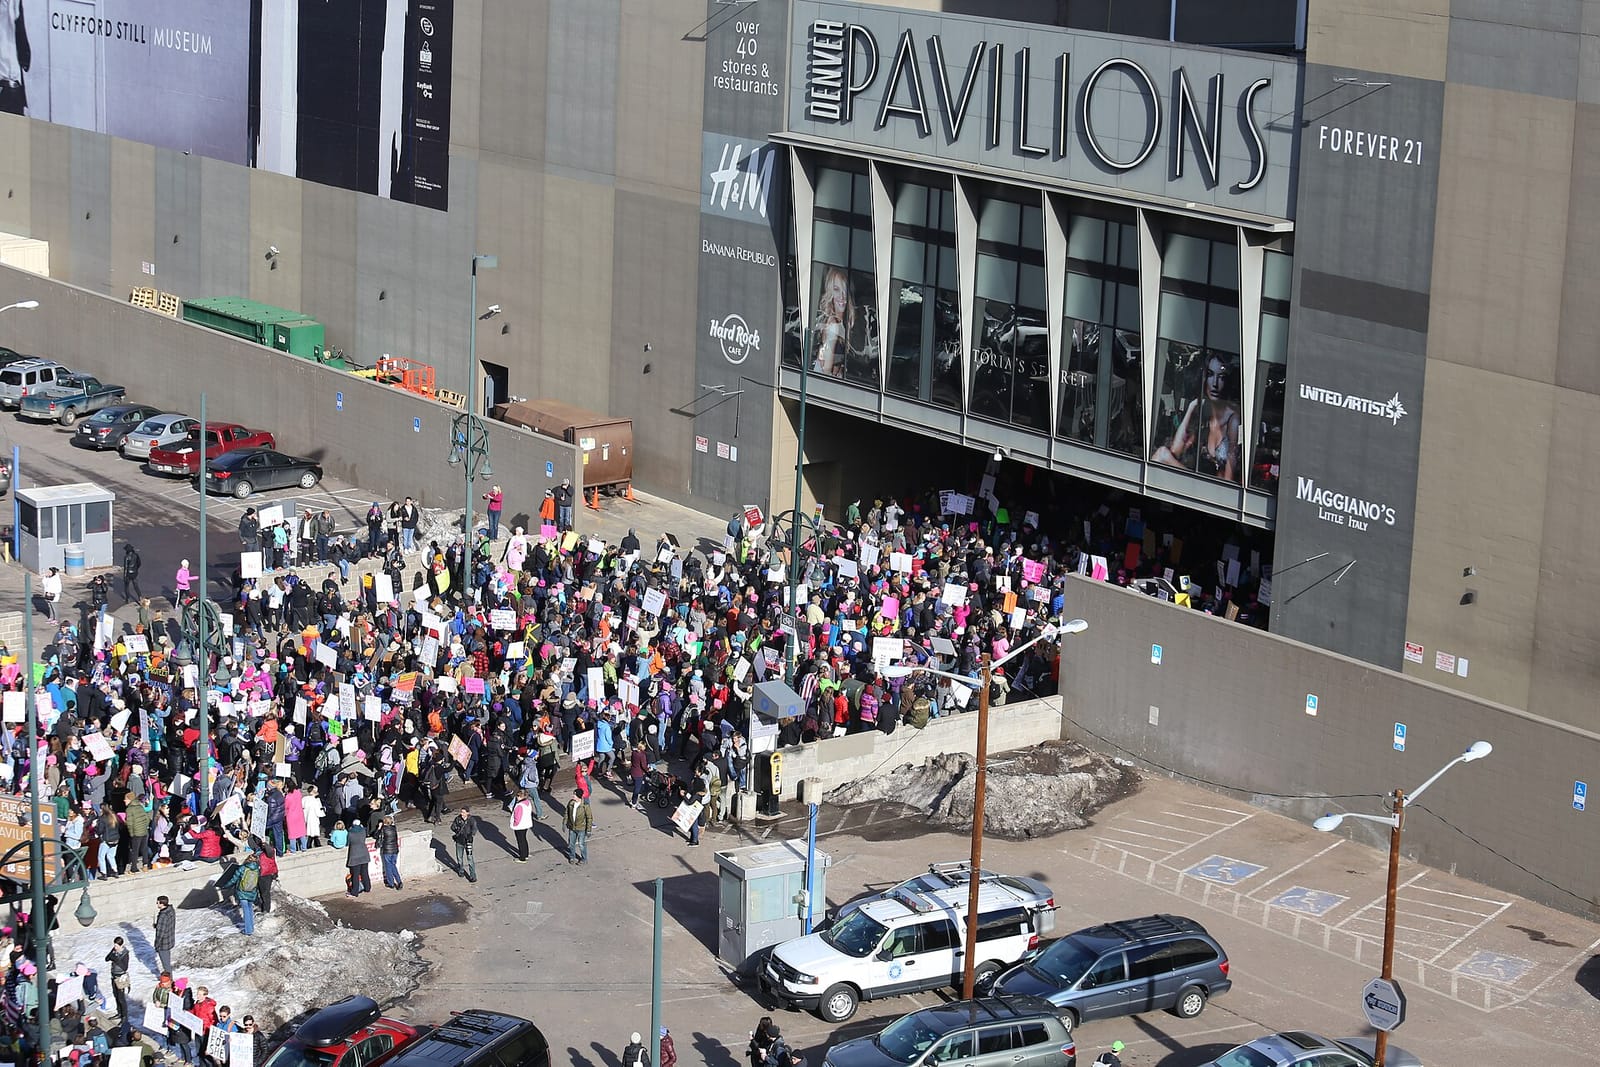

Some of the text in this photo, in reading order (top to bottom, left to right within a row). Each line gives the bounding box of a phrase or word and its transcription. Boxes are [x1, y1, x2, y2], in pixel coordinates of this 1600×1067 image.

[51, 12, 212, 55] CLYFFORD STILL MUSEUM
[735, 20, 760, 35] over
[735, 38, 758, 57] 40
[722, 58, 770, 78] stores &
[809, 19, 846, 121] DENVER
[713, 75, 778, 96] restaurants
[846, 24, 1270, 190] PAVILIONS
[1319, 125, 1423, 165] FOREVER 21
[710, 143, 776, 218] H&M
[702, 239, 775, 267] BANANA REPUBLIC
[709, 319, 760, 350] Hard Rock
[728, 345, 742, 356] CAFE
[1031, 361, 1088, 389] SERET
[1300, 383, 1394, 419] UNITED ARTISTS
